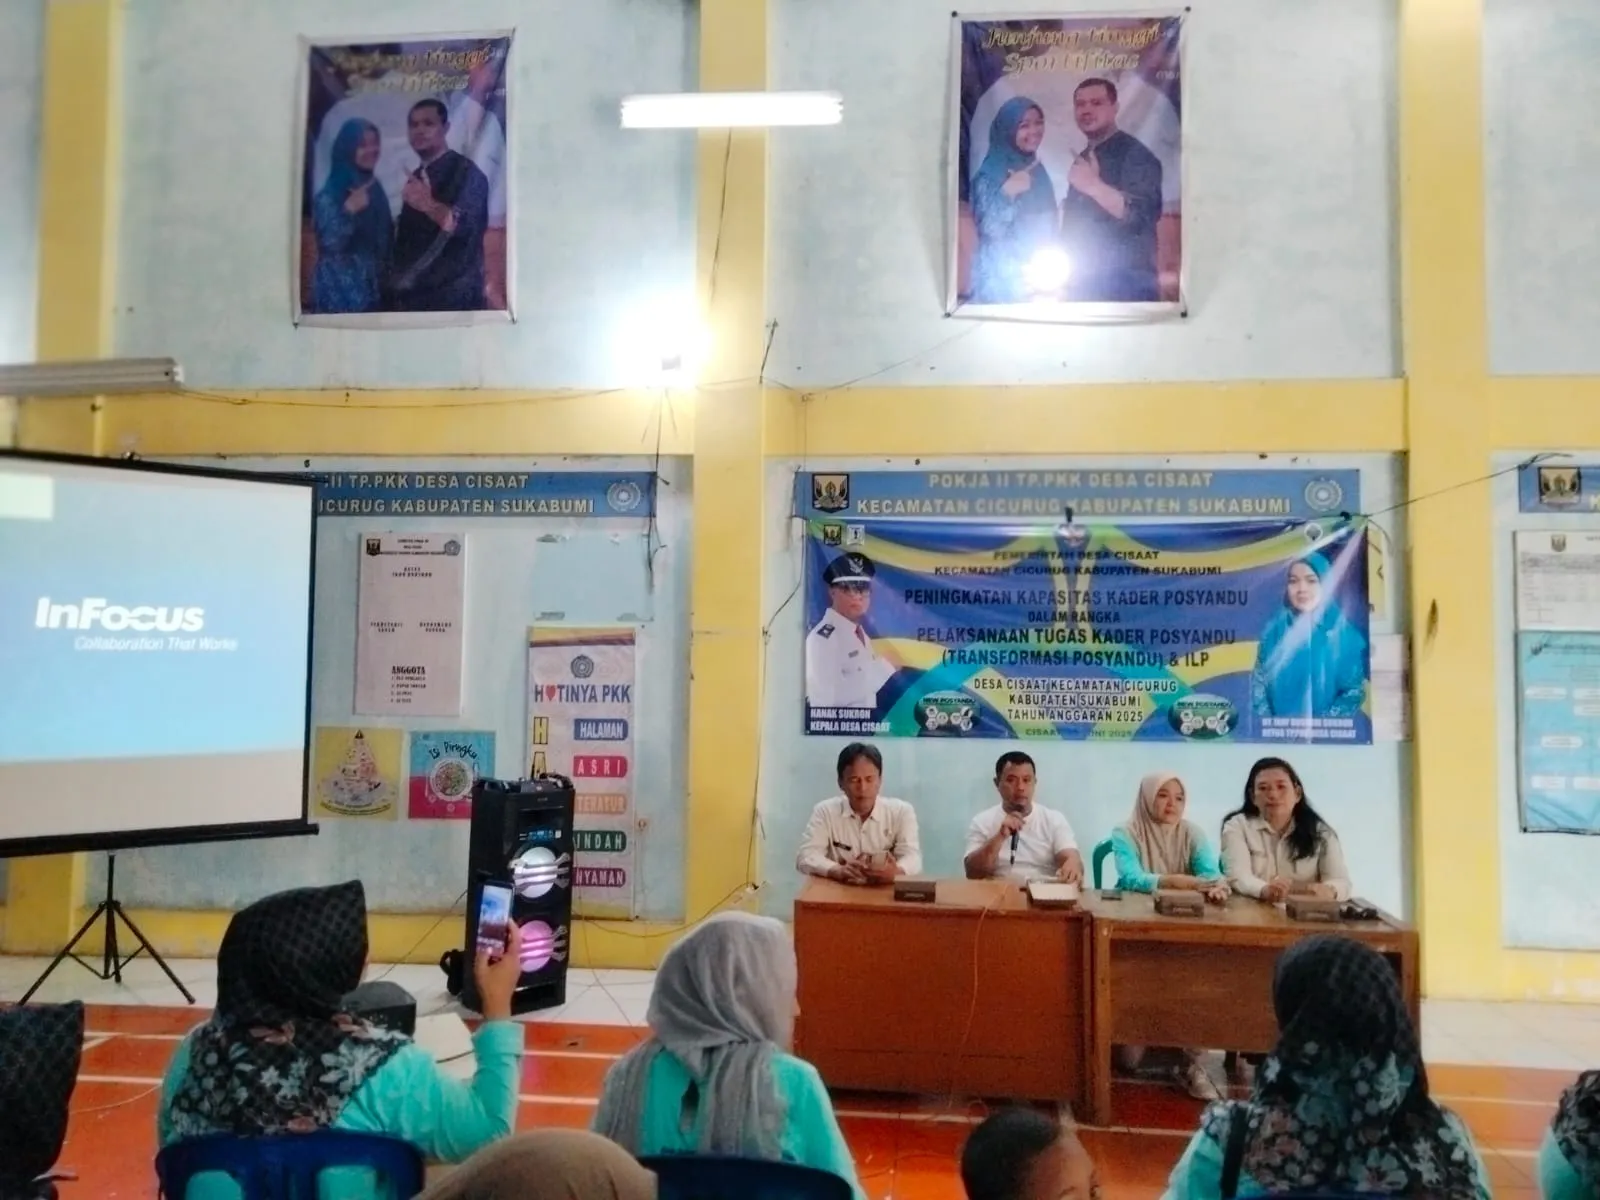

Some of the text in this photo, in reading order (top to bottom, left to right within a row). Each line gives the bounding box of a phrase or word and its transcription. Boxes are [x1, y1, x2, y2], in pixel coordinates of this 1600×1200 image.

[350, 475, 409, 488] TP.PKK
[415, 475, 459, 488] DESA
[466, 475, 529, 488] CISAAT
[929, 472, 1213, 488] POKJA II TP.PKK DESA CISAAT
[319, 499, 595, 513] ICURUG KABUPATEN SUKABUMI
[857, 498, 1292, 514] KECAMATAN CICURUG KABUPATEN SUKABUMI
[1114, 551, 1160, 560] CISAAT
[934, 566, 1222, 576] KECAMATAN CICURUG KABUPATEN SUKABUMI
[904, 589, 1249, 605] PENINGKATAN KAPASITAS KADER POSYANDU
[35, 596, 205, 632] InFocus
[1028, 611, 1121, 623] DALAM RANGKA
[74, 636, 239, 651] Collaboration That Works
[917, 627, 1236, 645] PELAKSANAAN TUGAS KADER POSYANDU
[942, 649, 1210, 669] (TRANSFORMASI POSYANDU) & ILP
[391, 665, 426, 675] ANGGOTA
[974, 678, 1177, 692] DESA CISAAT KECAMATAN CICURUG
[602, 684, 631, 703] PKK
[1009, 694, 1141, 706] KABUPATEN SUKABUMI
[1008, 709, 1144, 723] TAHUN ANGGARAN 2025
[580, 721, 624, 739] HALAMAN
[810, 721, 839, 732] KEPALA
[840, 722, 861, 732] DESA
[1025, 728, 1057, 737] CISAA
[577, 758, 621, 775] ASRI
[576, 832, 622, 849] INDAH
[575, 868, 624, 885] NYAMAN
